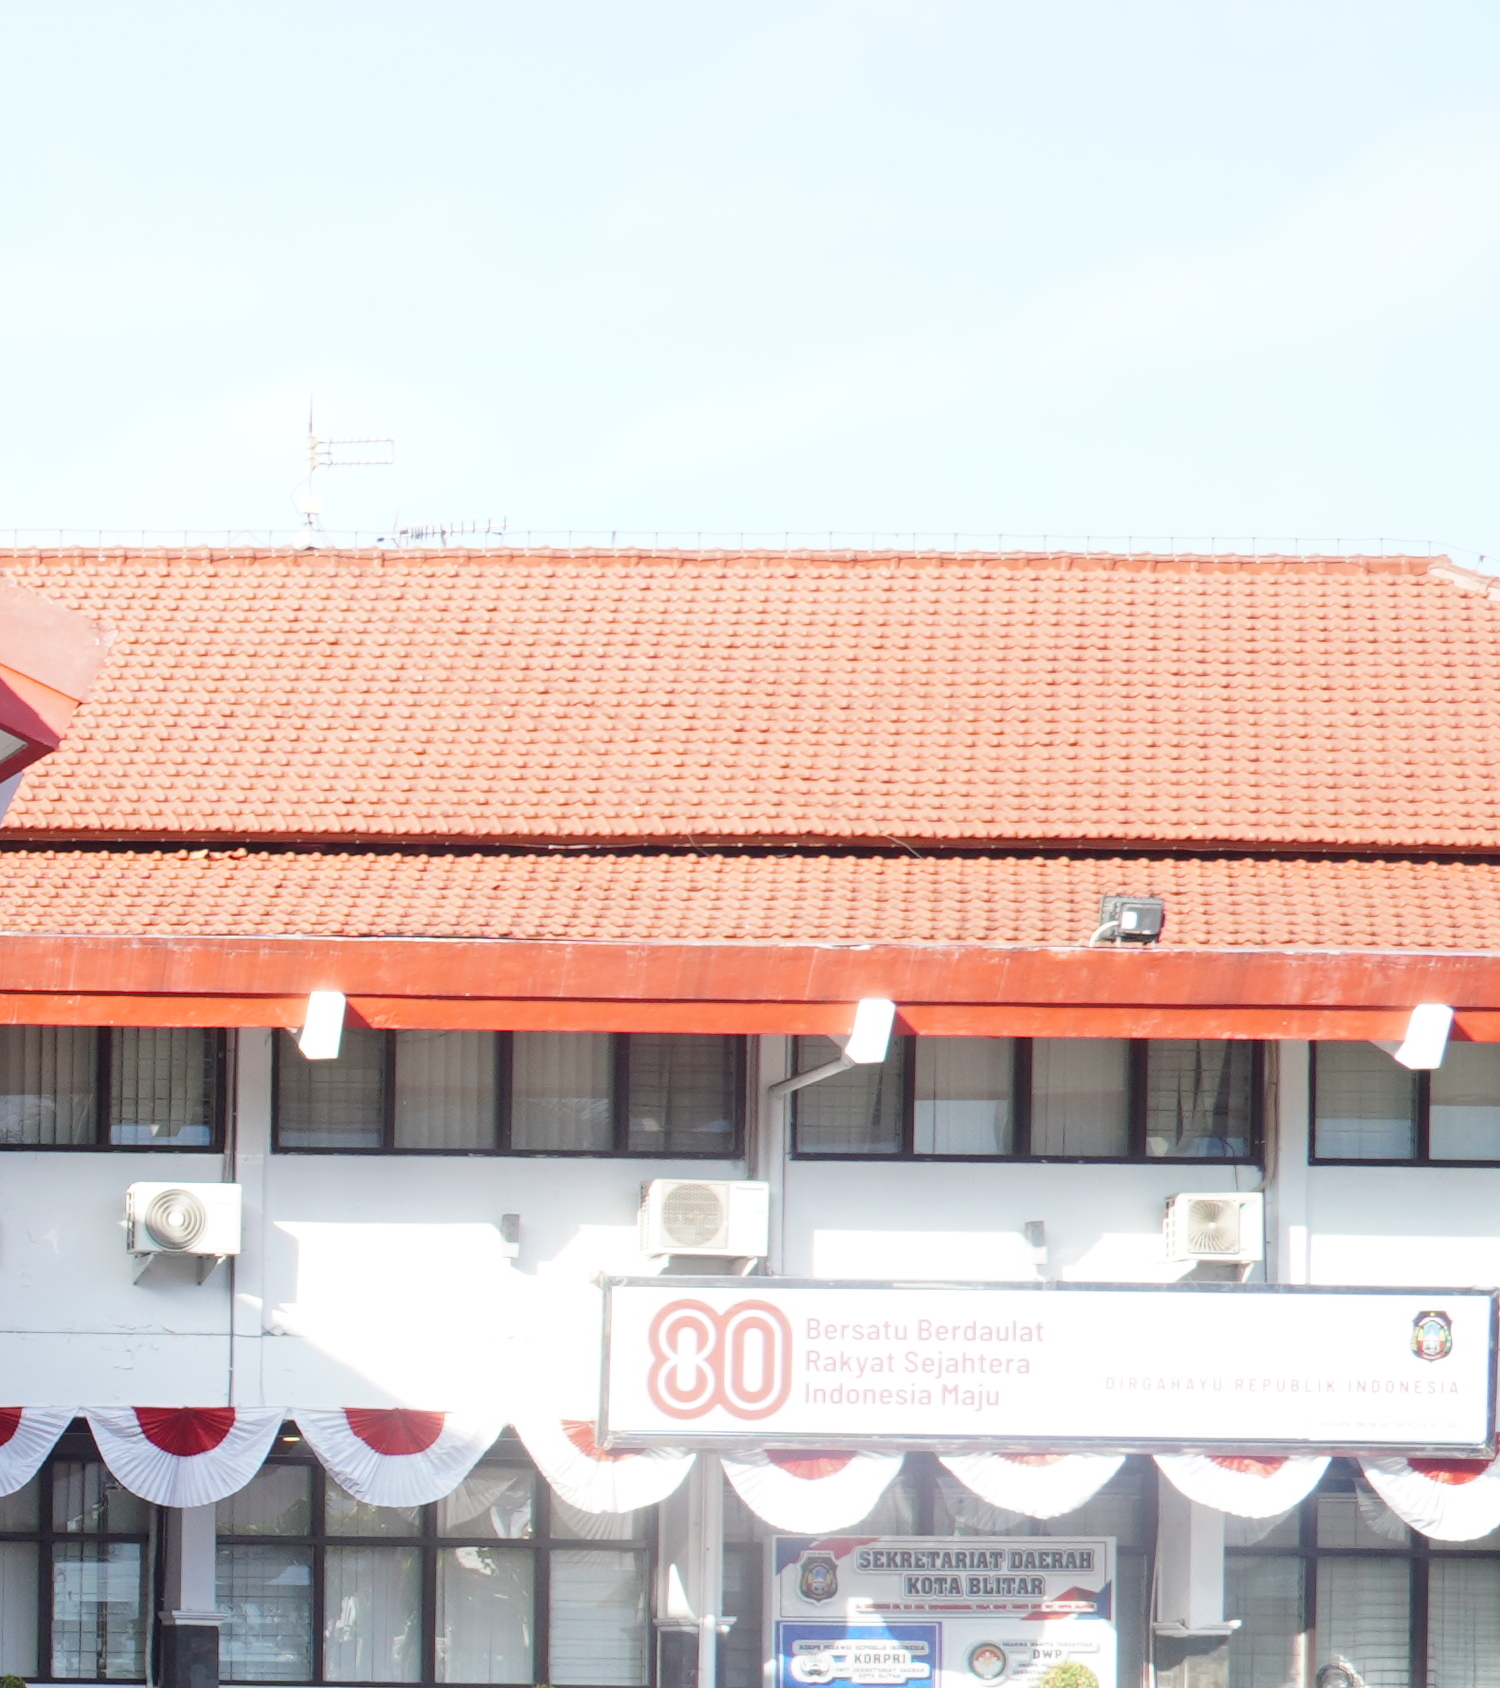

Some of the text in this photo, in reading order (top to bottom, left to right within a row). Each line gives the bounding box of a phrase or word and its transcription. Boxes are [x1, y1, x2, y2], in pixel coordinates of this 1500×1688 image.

[806, 1317, 1045, 1344] Bersatu Berdaulat
[805, 1350, 1031, 1380] Rakyat Sejahtera
[1106, 1377, 1459, 1395] DIRGAHAYU REPUBLIK INDONESIA
[805, 1382, 1000, 1412] Indonesia Maju
[858, 1550, 1092, 1570] SEKRETARIAT DAERAH
[906, 1576, 1044, 1596] KOTA BLITAR
[854, 1653, 907, 1664] KORPRI
[1033, 1649, 1062, 1659] DWP
